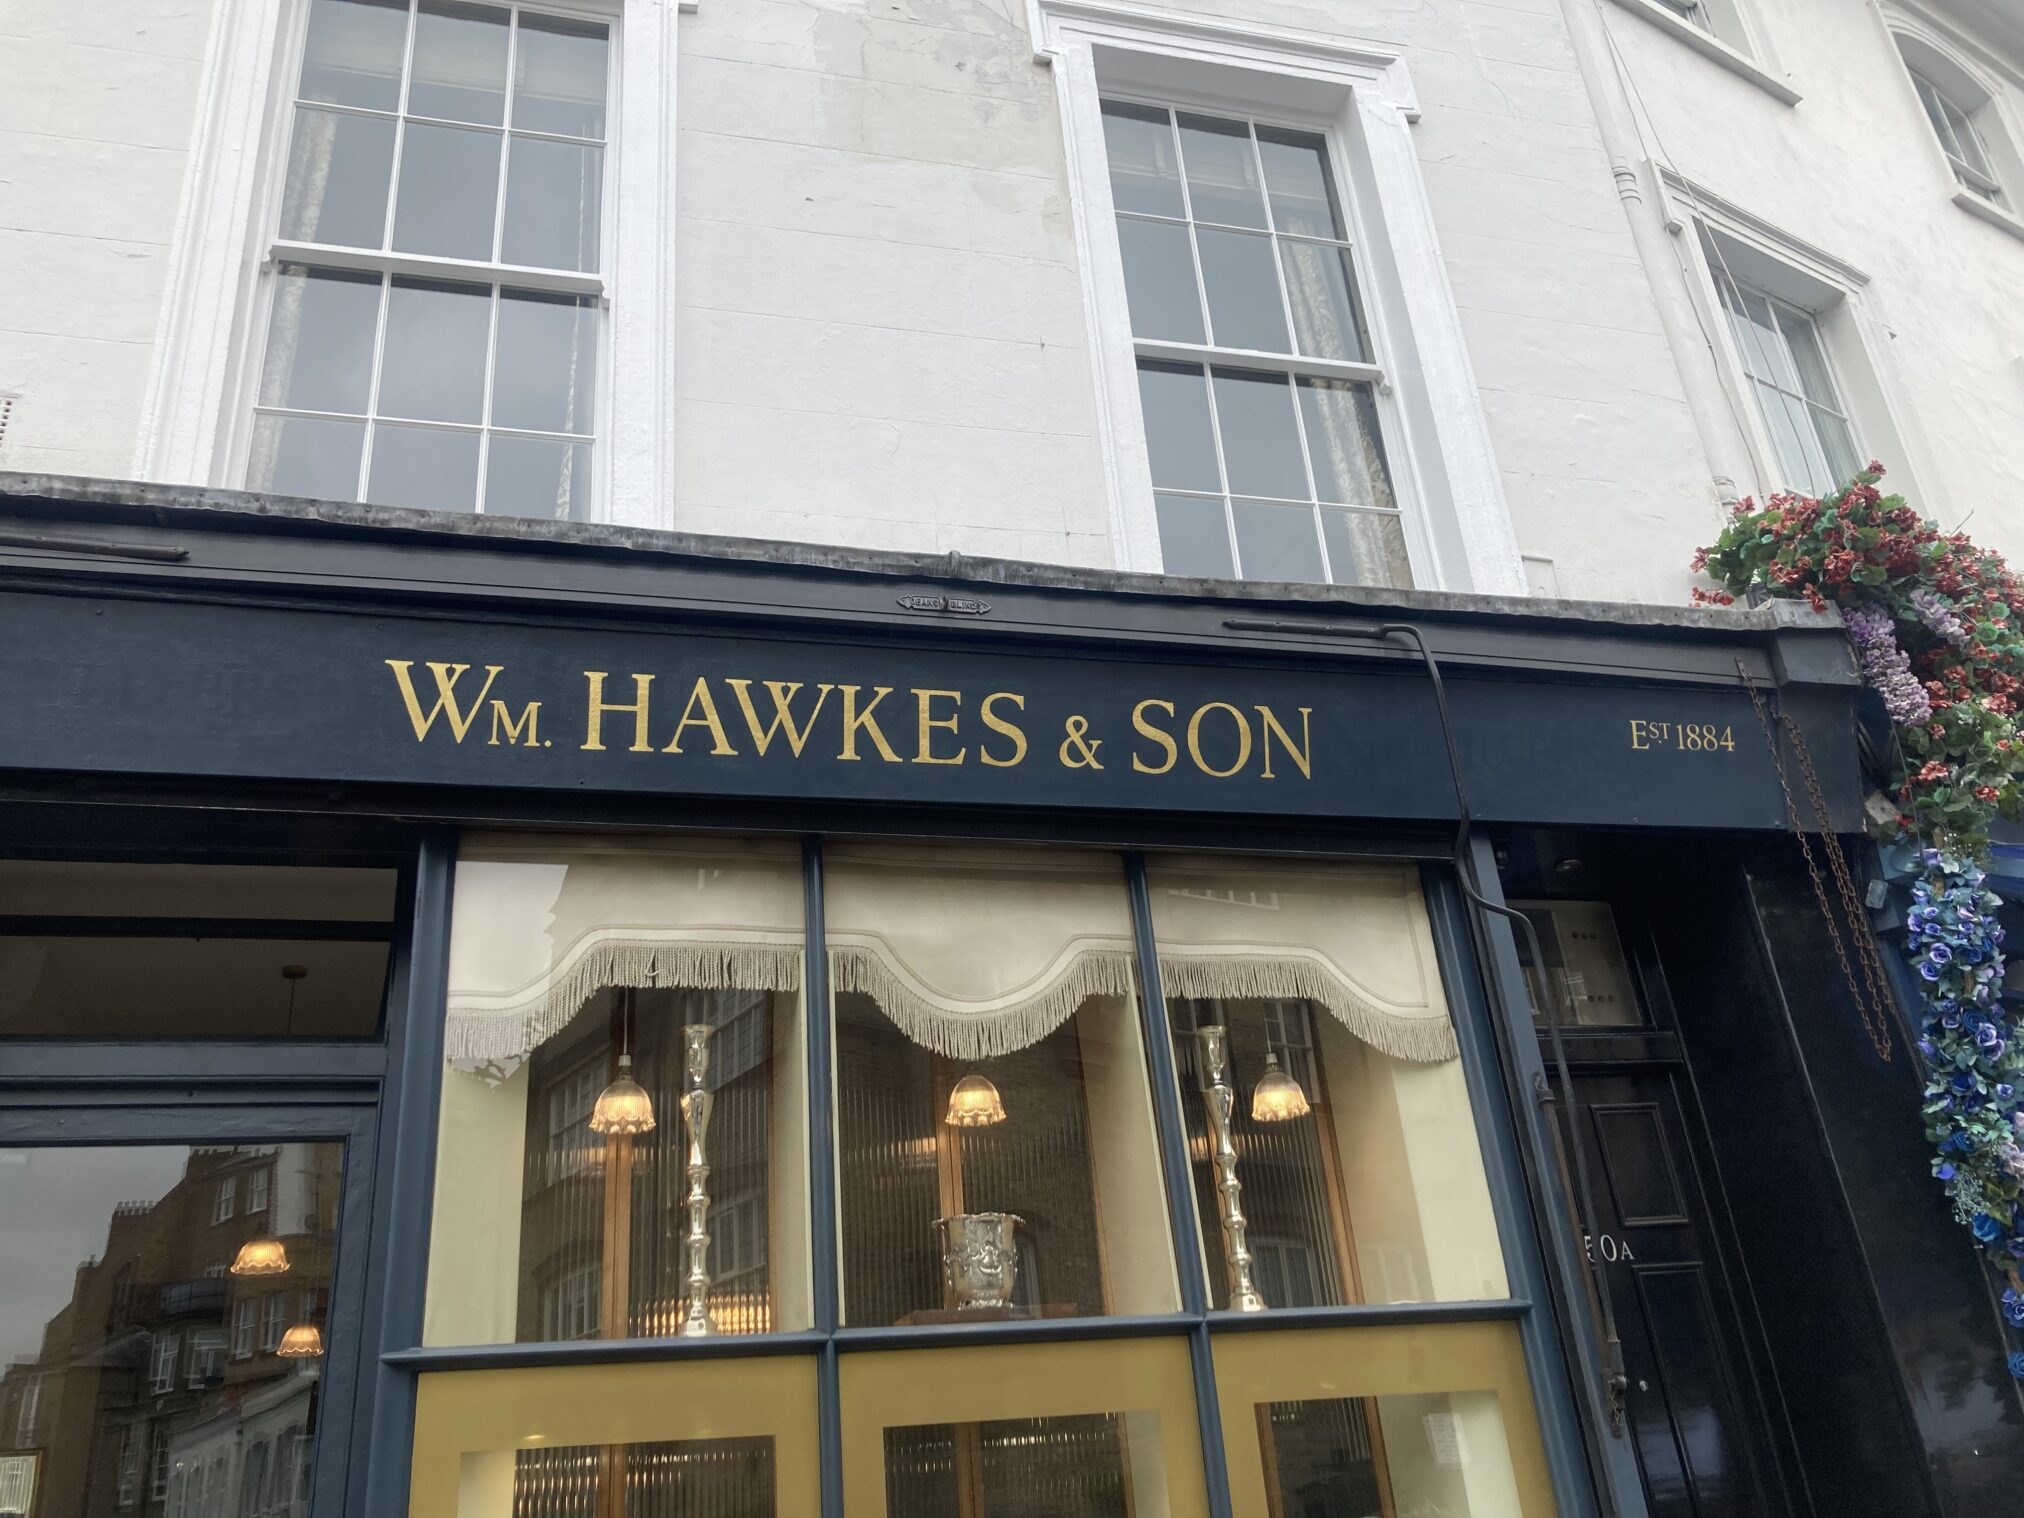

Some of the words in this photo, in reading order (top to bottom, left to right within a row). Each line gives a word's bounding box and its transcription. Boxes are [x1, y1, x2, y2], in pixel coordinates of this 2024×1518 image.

[580, 671, 1028, 768] HAWKES
[1059, 715, 1104, 770] &
[1132, 700, 1312, 779] SON
[1676, 723, 1735, 752] 1884
